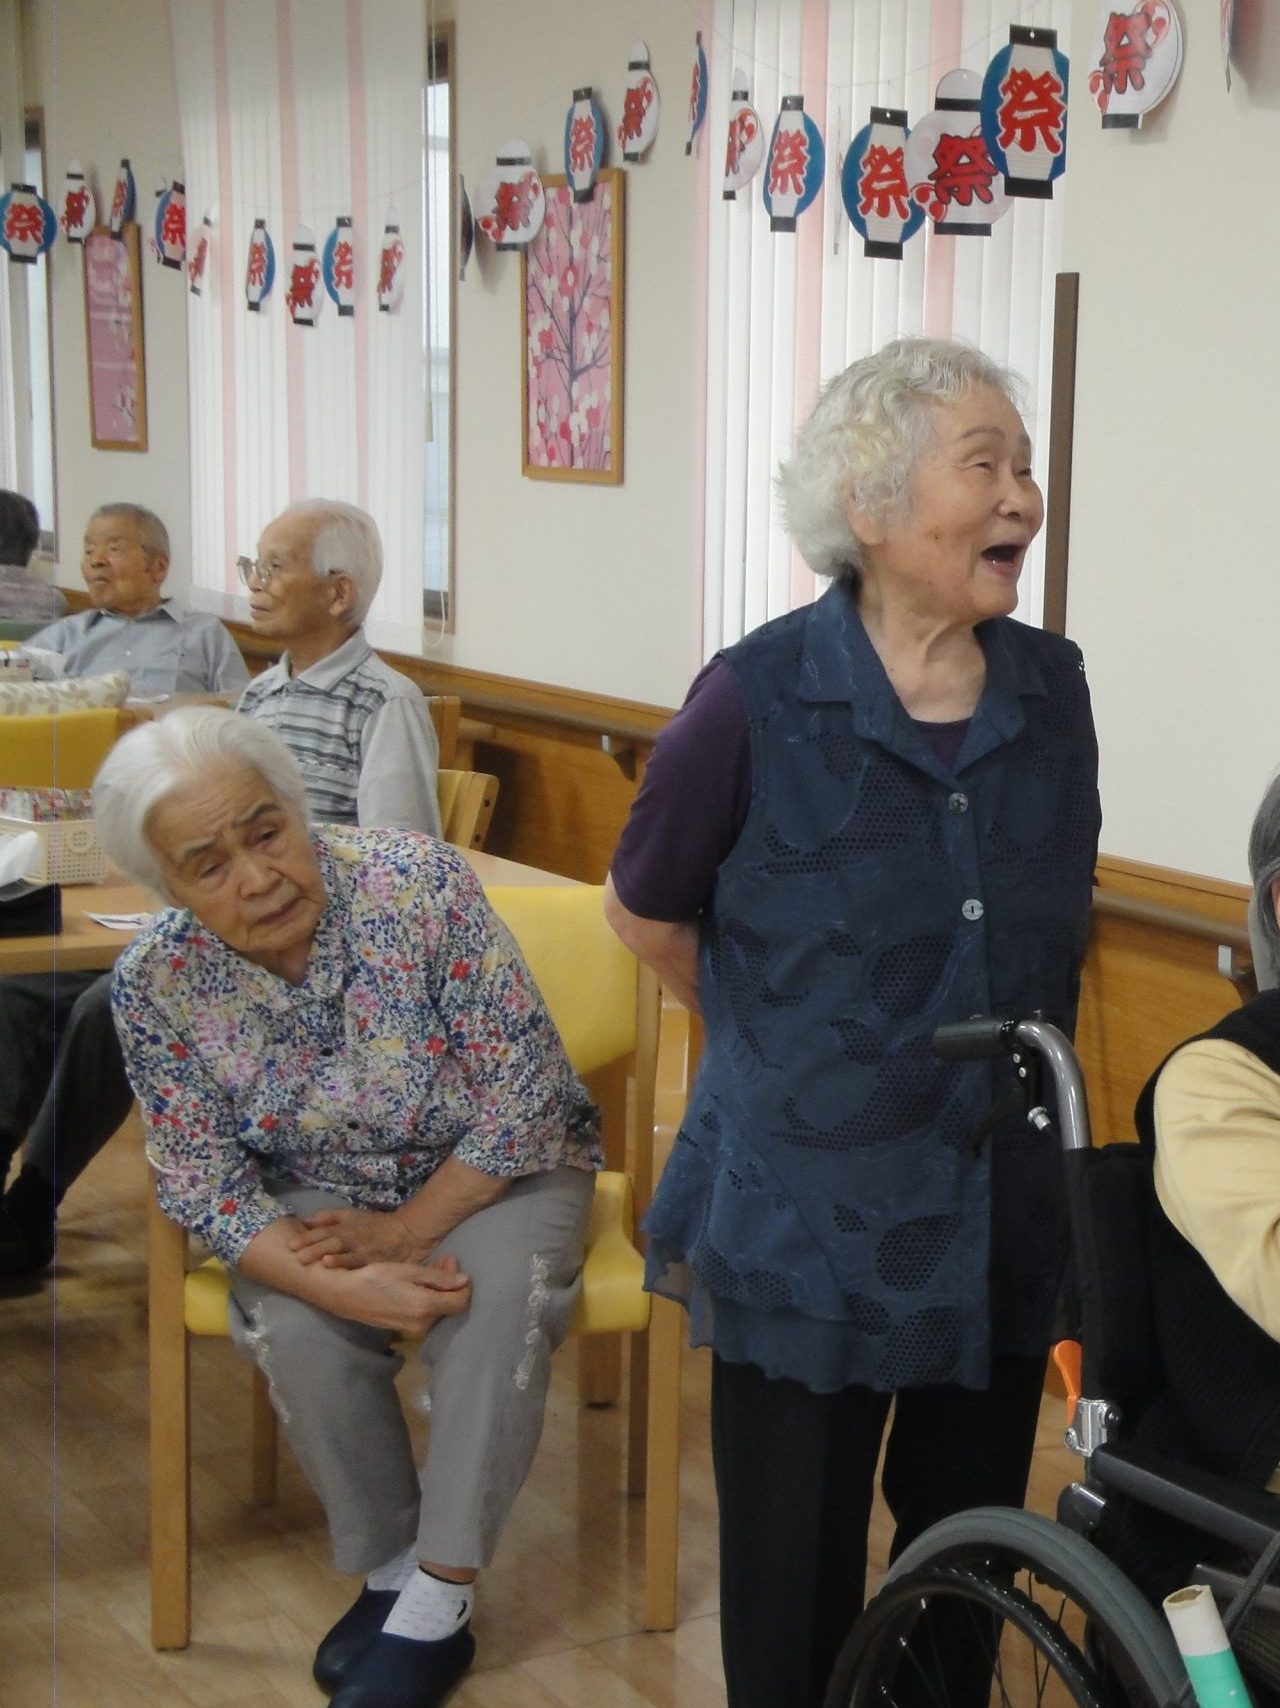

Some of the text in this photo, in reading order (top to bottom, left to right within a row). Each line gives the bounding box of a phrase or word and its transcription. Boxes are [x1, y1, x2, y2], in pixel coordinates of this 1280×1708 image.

[1099, 12, 1152, 95] 祭
[571, 115, 595, 172] 祭
[1000, 67, 1067, 155] 祭
[769, 129, 809, 195] 祭
[858, 144, 909, 220] 祭
[928, 133, 999, 207] 祭
[5, 202, 43, 244] 祭
[249, 243, 266, 287] 祭
